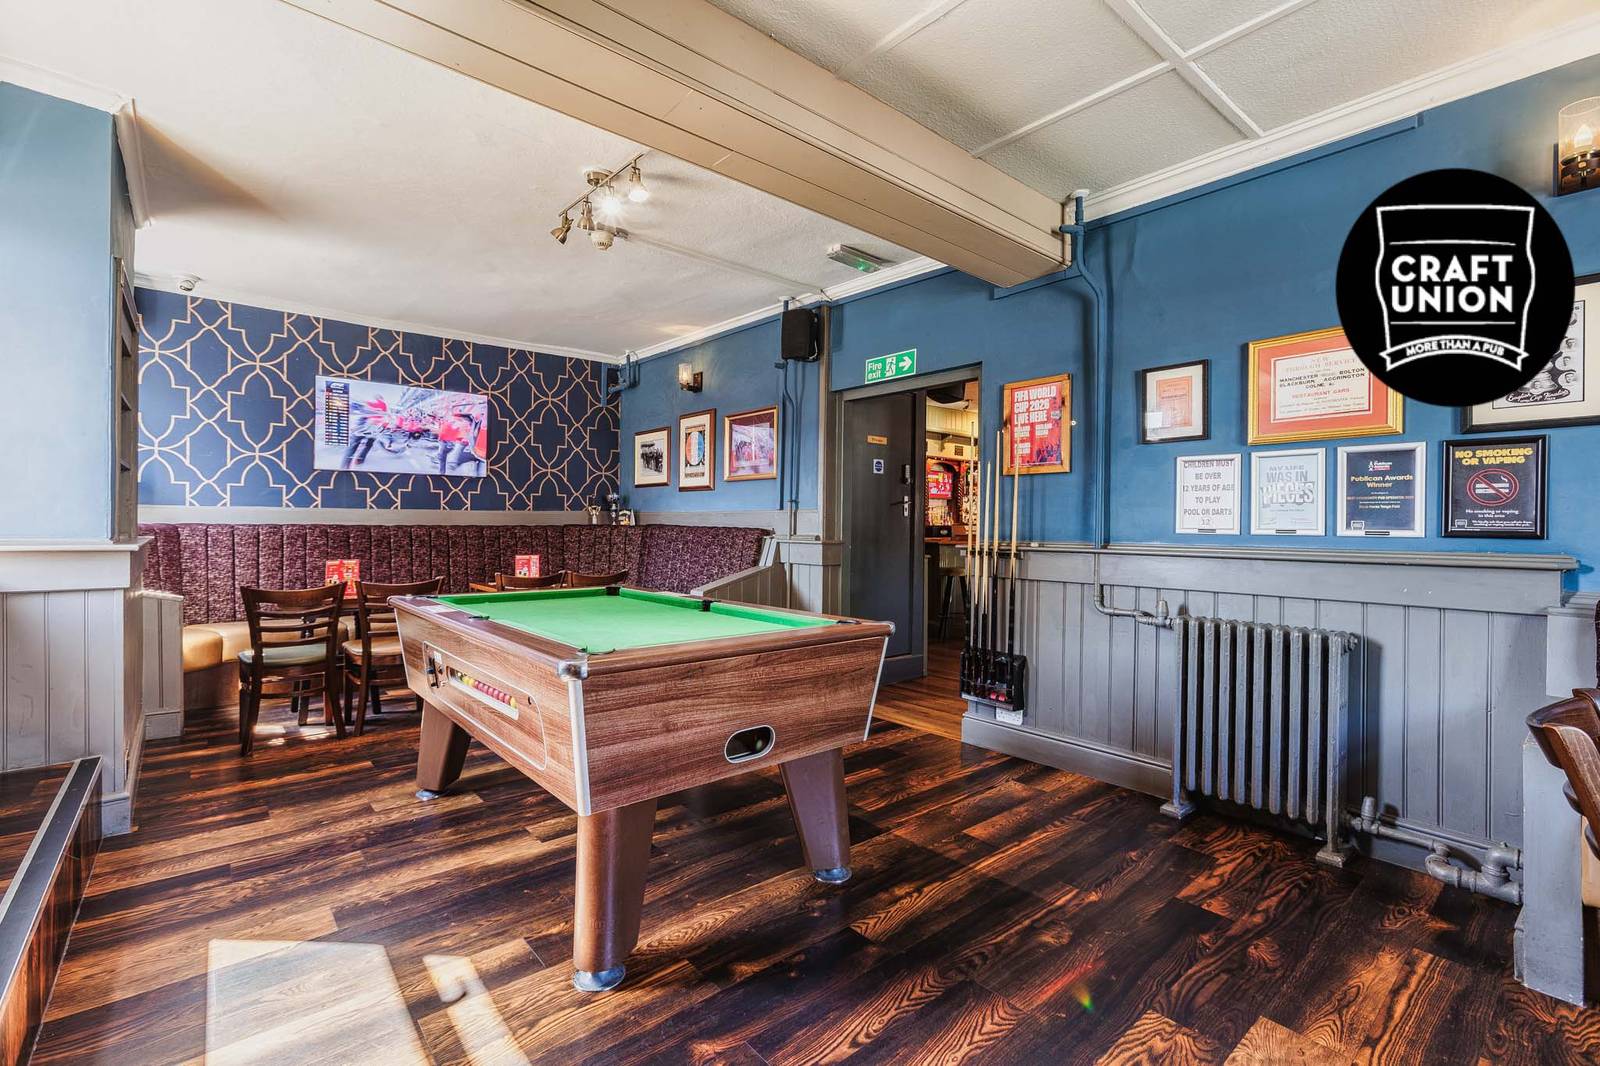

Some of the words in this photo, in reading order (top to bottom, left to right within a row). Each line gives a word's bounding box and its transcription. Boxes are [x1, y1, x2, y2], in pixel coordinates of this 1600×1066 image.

[868, 362, 882, 371] Fire
[868, 370, 881, 380] exit
[1279, 374, 1318, 383] MANCHESTER
[1279, 380, 1315, 388] BLACKBURN
[1323, 373, 1365, 382] ACCRINGTON
[1014, 390, 1029, 402] FIFA
[1029, 386, 1057, 399] WORLD
[1014, 401, 1029, 414] CUP
[1014, 412, 1029, 425] LIVE
[1029, 410, 1048, 423] HERE
[1455, 450, 1473, 459] NO
[1475, 447, 1534, 457] SMOKING
[1183, 460, 1214, 469] CHILDREN
[1215, 460, 1233, 468] MUST
[1461, 458, 1479, 466] OR
[1482, 456, 1526, 465] VAPING
[1195, 472, 1203, 480] BE
[1204, 472, 1222, 480] OVER
[1266, 471, 1293, 483] WAS
[1295, 470, 1309, 482] IN
[1190, 484, 1211, 492] YEARS
[1211, 484, 1221, 492] OF
[1261, 481, 1315, 505] PIECES
[1195, 496, 1203, 504] TO
[1204, 496, 1221, 504] PLAY
[1183, 508, 1200, 516] POOL
[1211, 508, 1232, 516] DARTS
